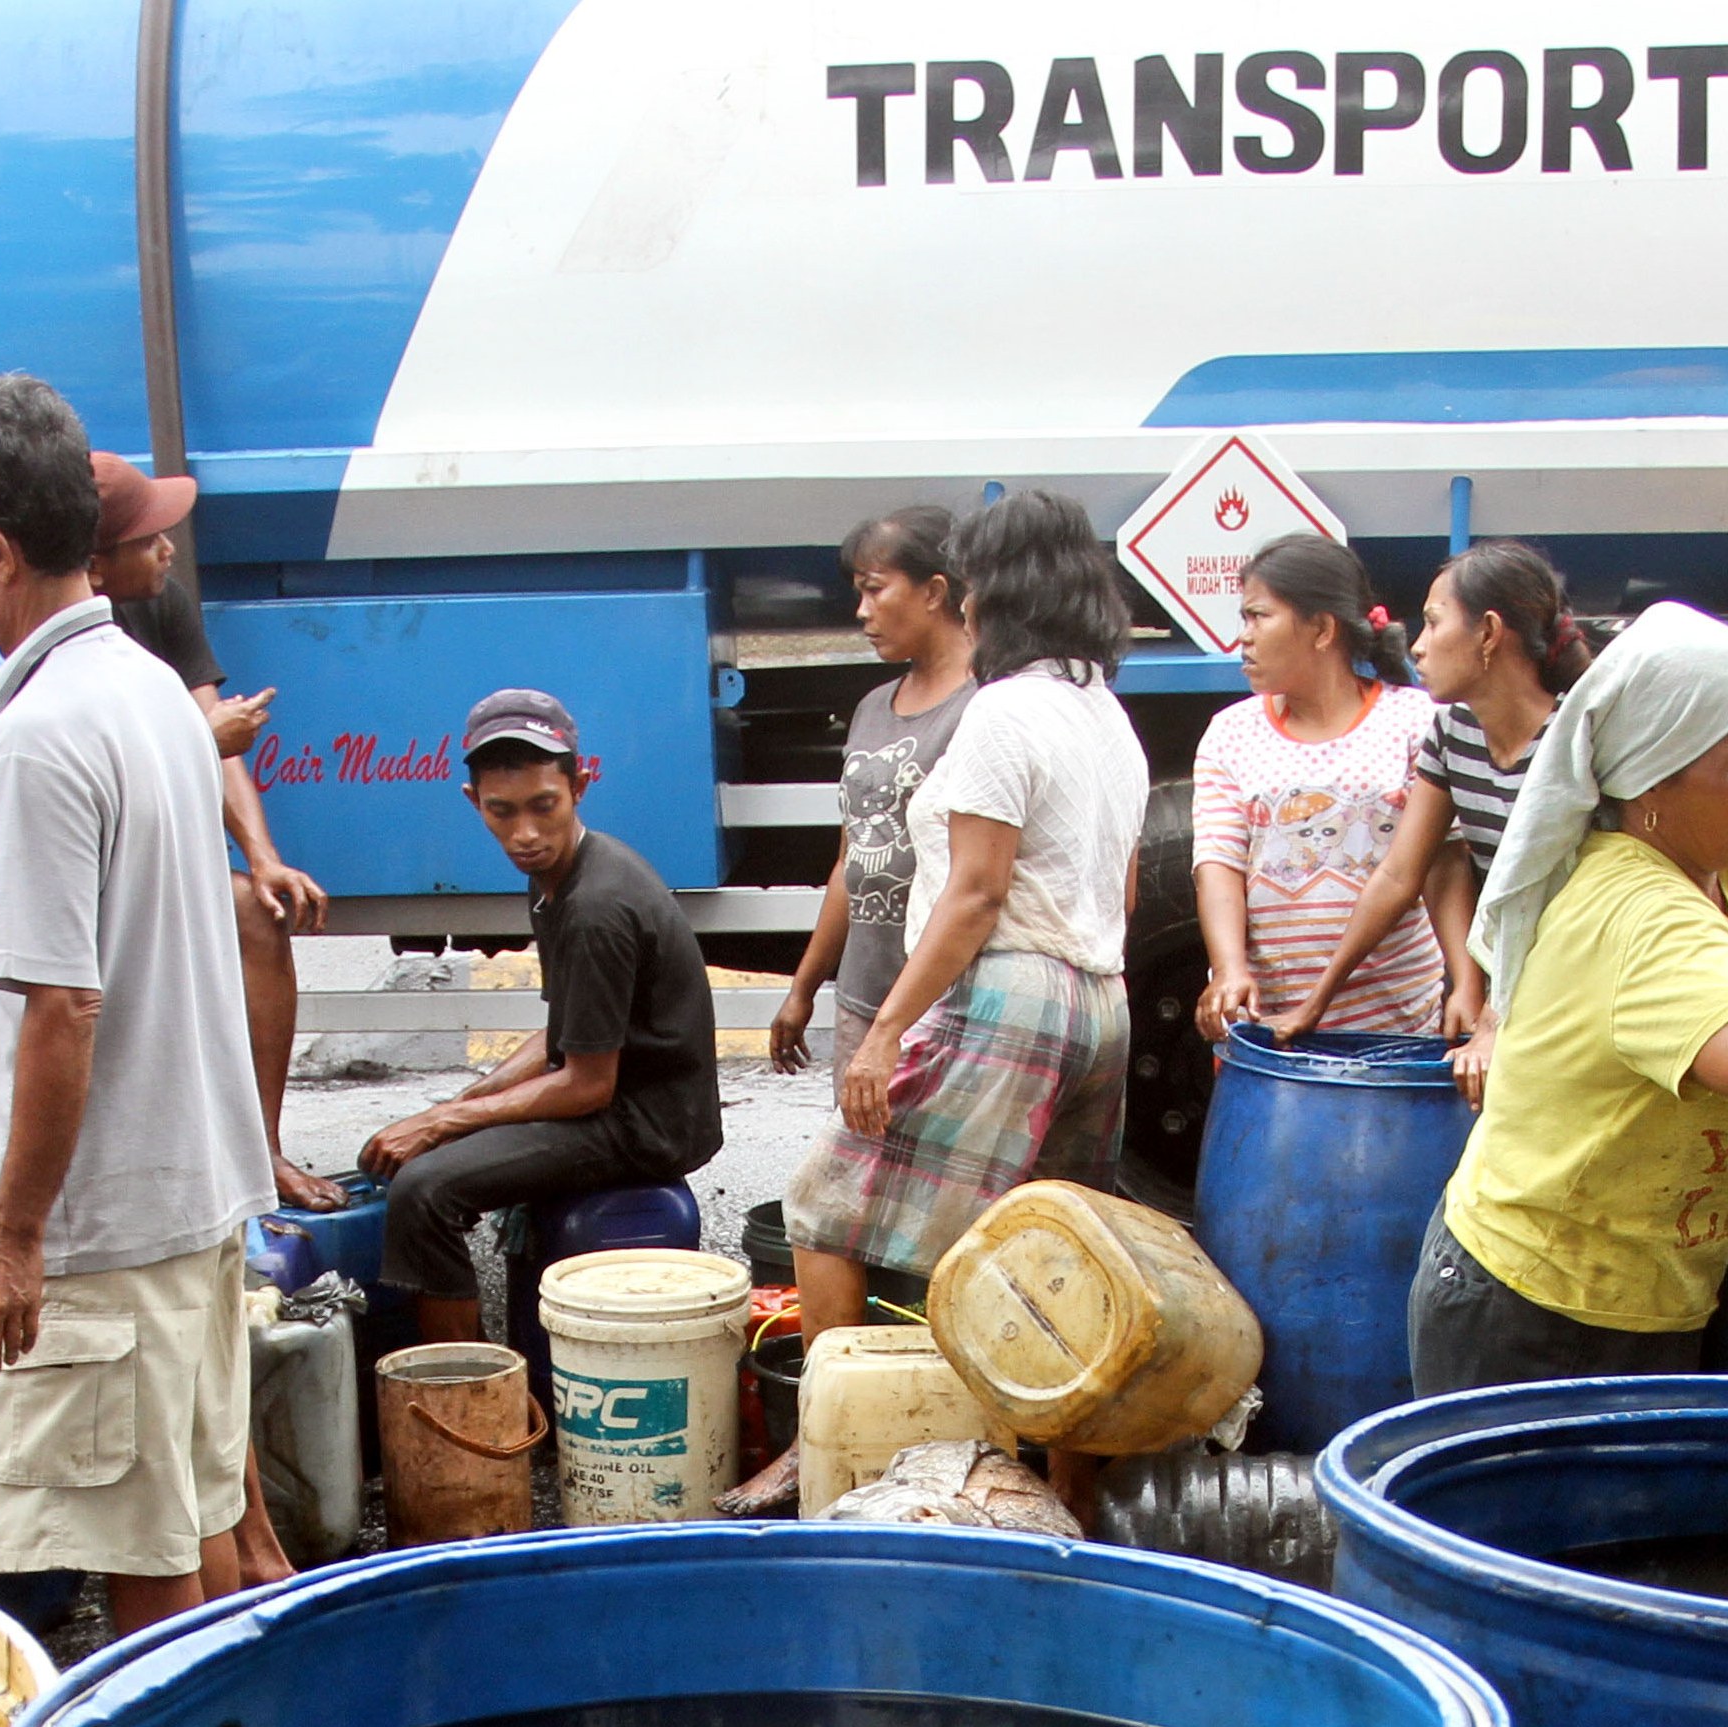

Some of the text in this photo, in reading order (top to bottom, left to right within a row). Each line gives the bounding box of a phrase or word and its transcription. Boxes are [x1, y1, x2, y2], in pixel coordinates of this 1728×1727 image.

[1186, 555, 1218, 574] BAHAN
[1187, 576, 1221, 595] MUDAH
[252, 733, 324, 794] Cair
[333, 732, 451, 785] Mudah
[589, 1472, 605, 1485] 40
